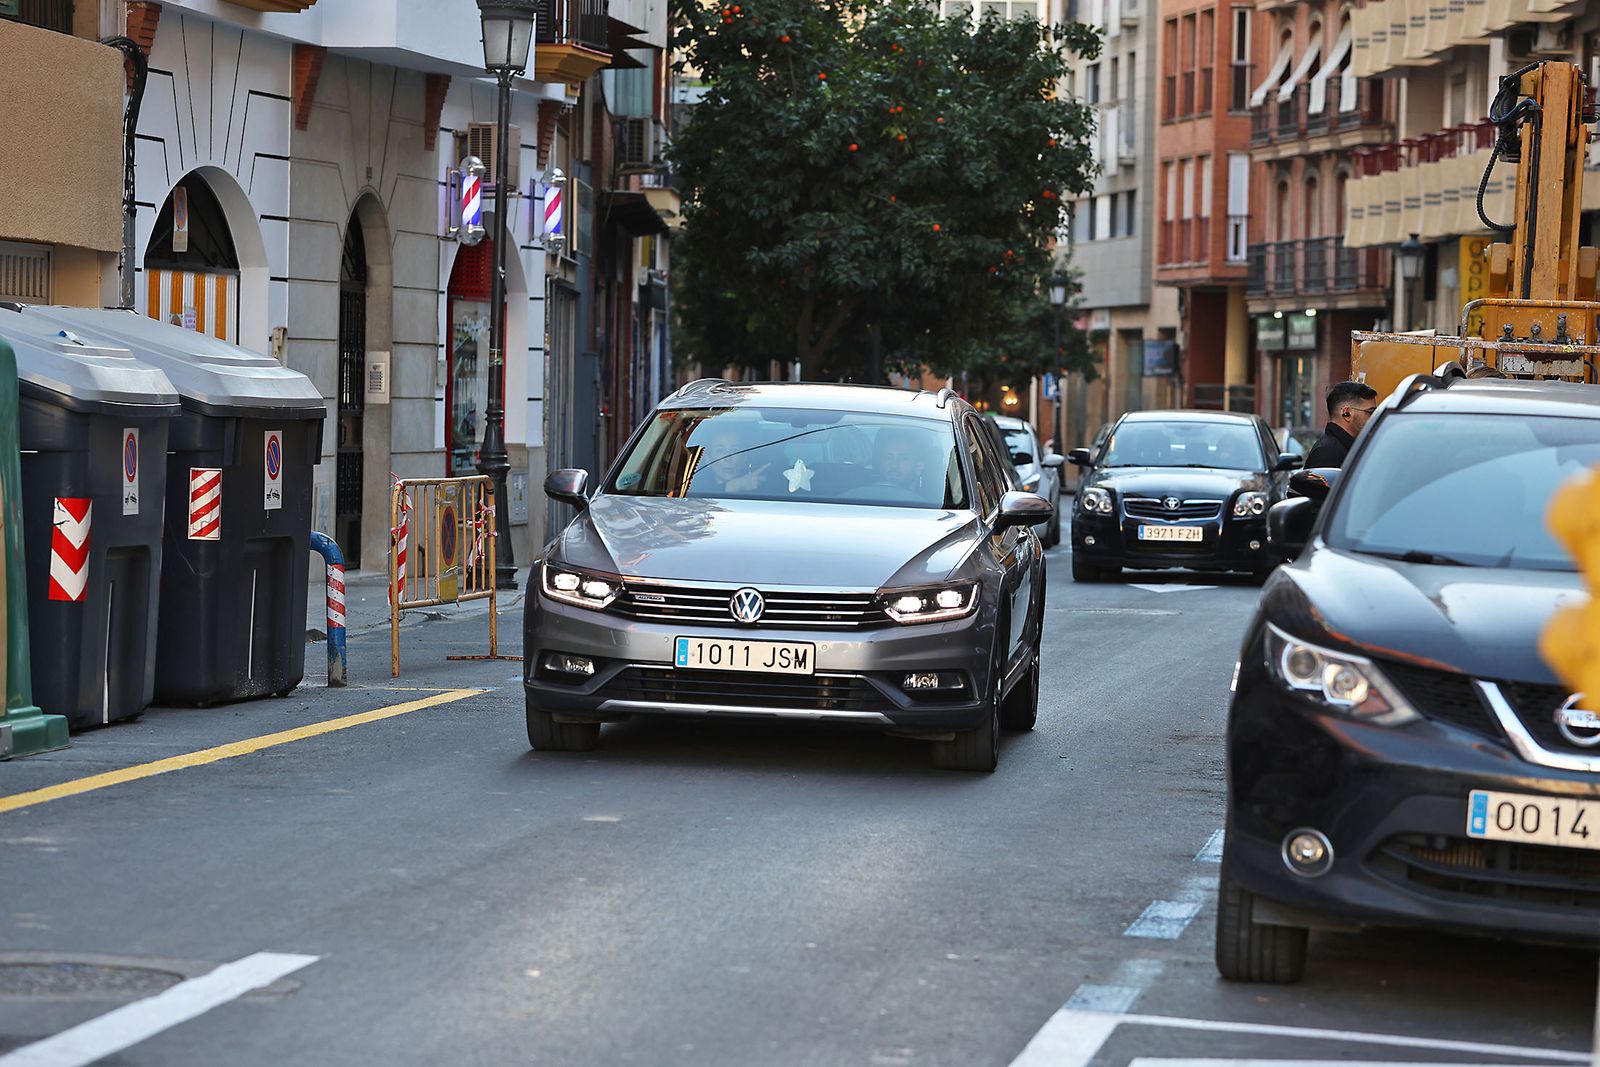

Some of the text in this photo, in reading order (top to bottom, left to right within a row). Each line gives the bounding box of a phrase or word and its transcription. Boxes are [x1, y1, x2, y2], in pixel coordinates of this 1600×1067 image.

[1146, 527, 1200, 540] 3971 FZH
[697, 643, 750, 667] 1011
[763, 646, 808, 670] JSM
[1496, 801, 1590, 839] 0014
